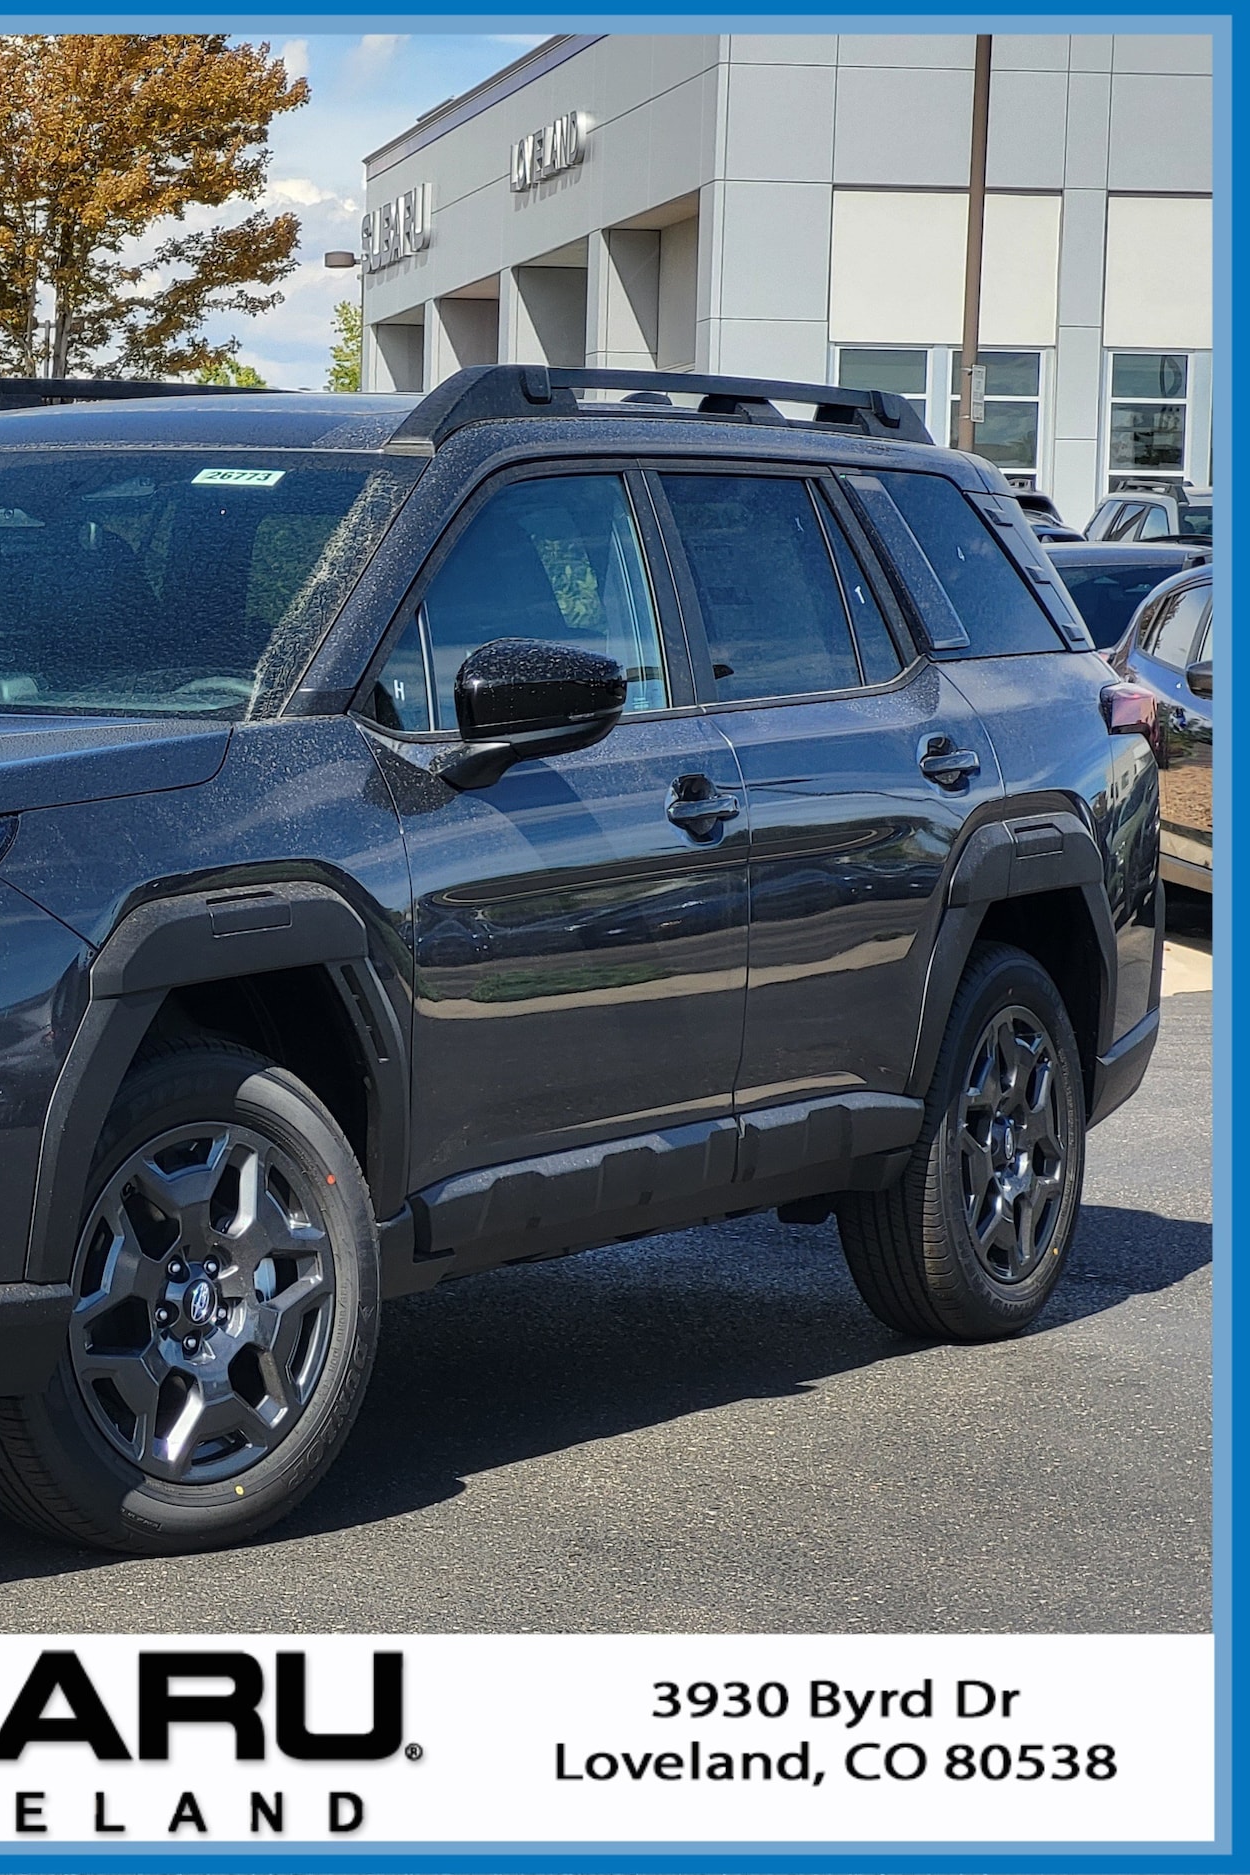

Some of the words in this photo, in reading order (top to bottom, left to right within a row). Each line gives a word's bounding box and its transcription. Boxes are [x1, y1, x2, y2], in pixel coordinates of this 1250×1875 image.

[510, 111, 588, 192] LOVELAND
[362, 182, 433, 274] SUBARU
[204, 470, 274, 482] 26773
[393, 679, 405, 701] H
